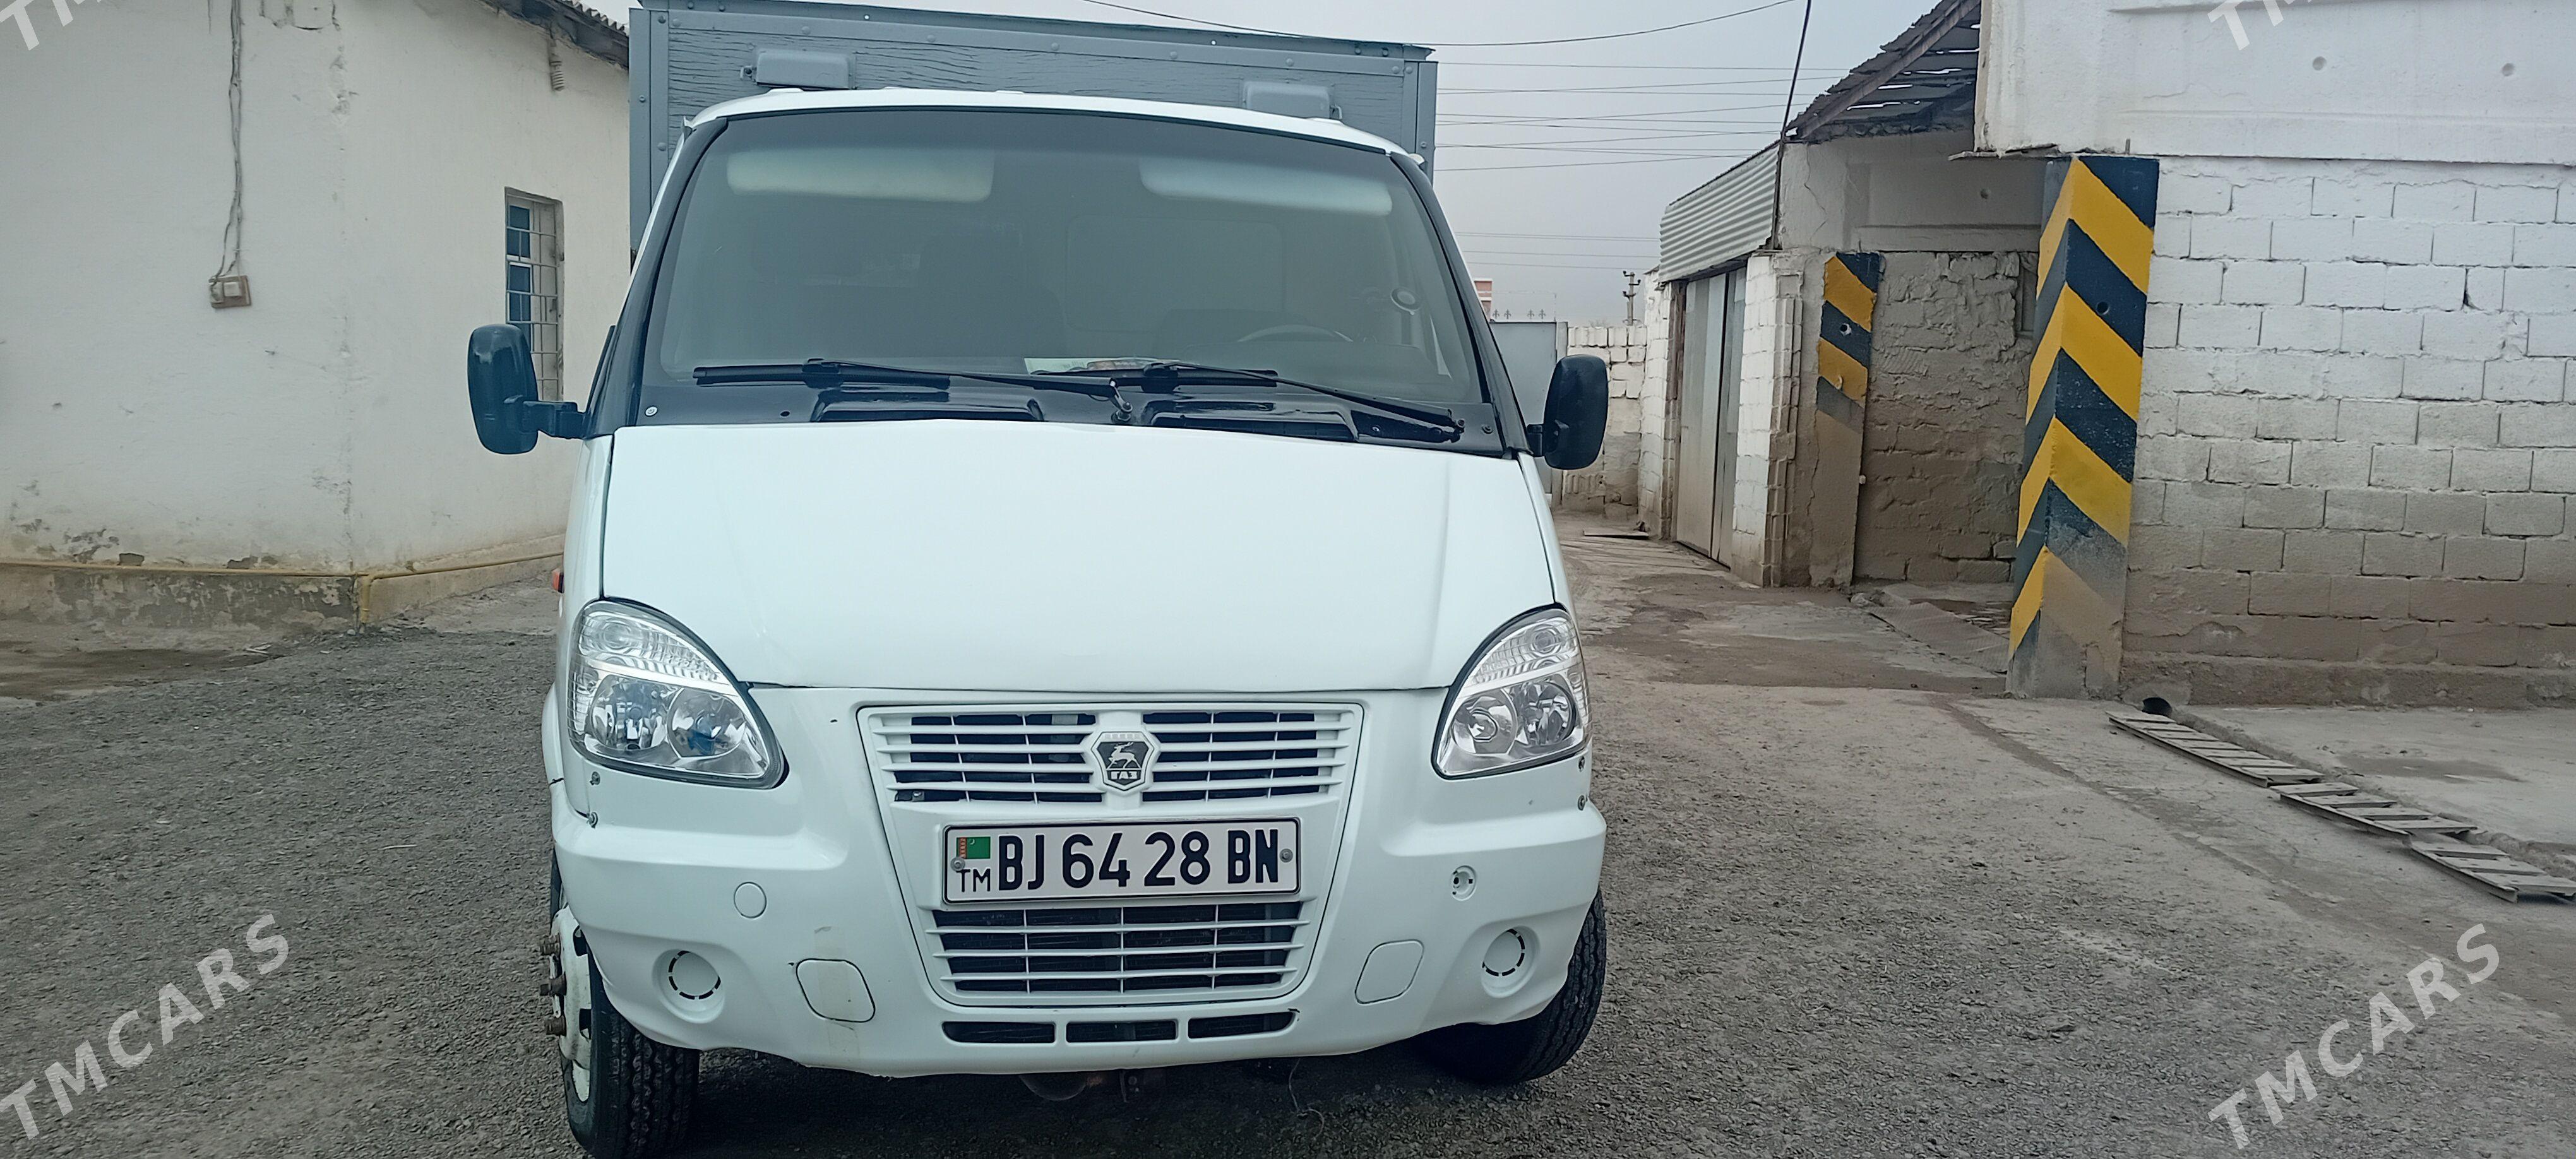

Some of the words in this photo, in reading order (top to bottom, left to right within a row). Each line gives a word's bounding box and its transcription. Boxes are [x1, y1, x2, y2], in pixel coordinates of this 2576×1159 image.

[1111, 771, 1138, 780] ГАЗ
[998, 834, 1044, 891] BJ
[1062, 833, 1131, 889] 64
[1144, 831, 1211, 887] 28
[1227, 829, 1279, 884] BN
[956, 868, 991, 892] TM
